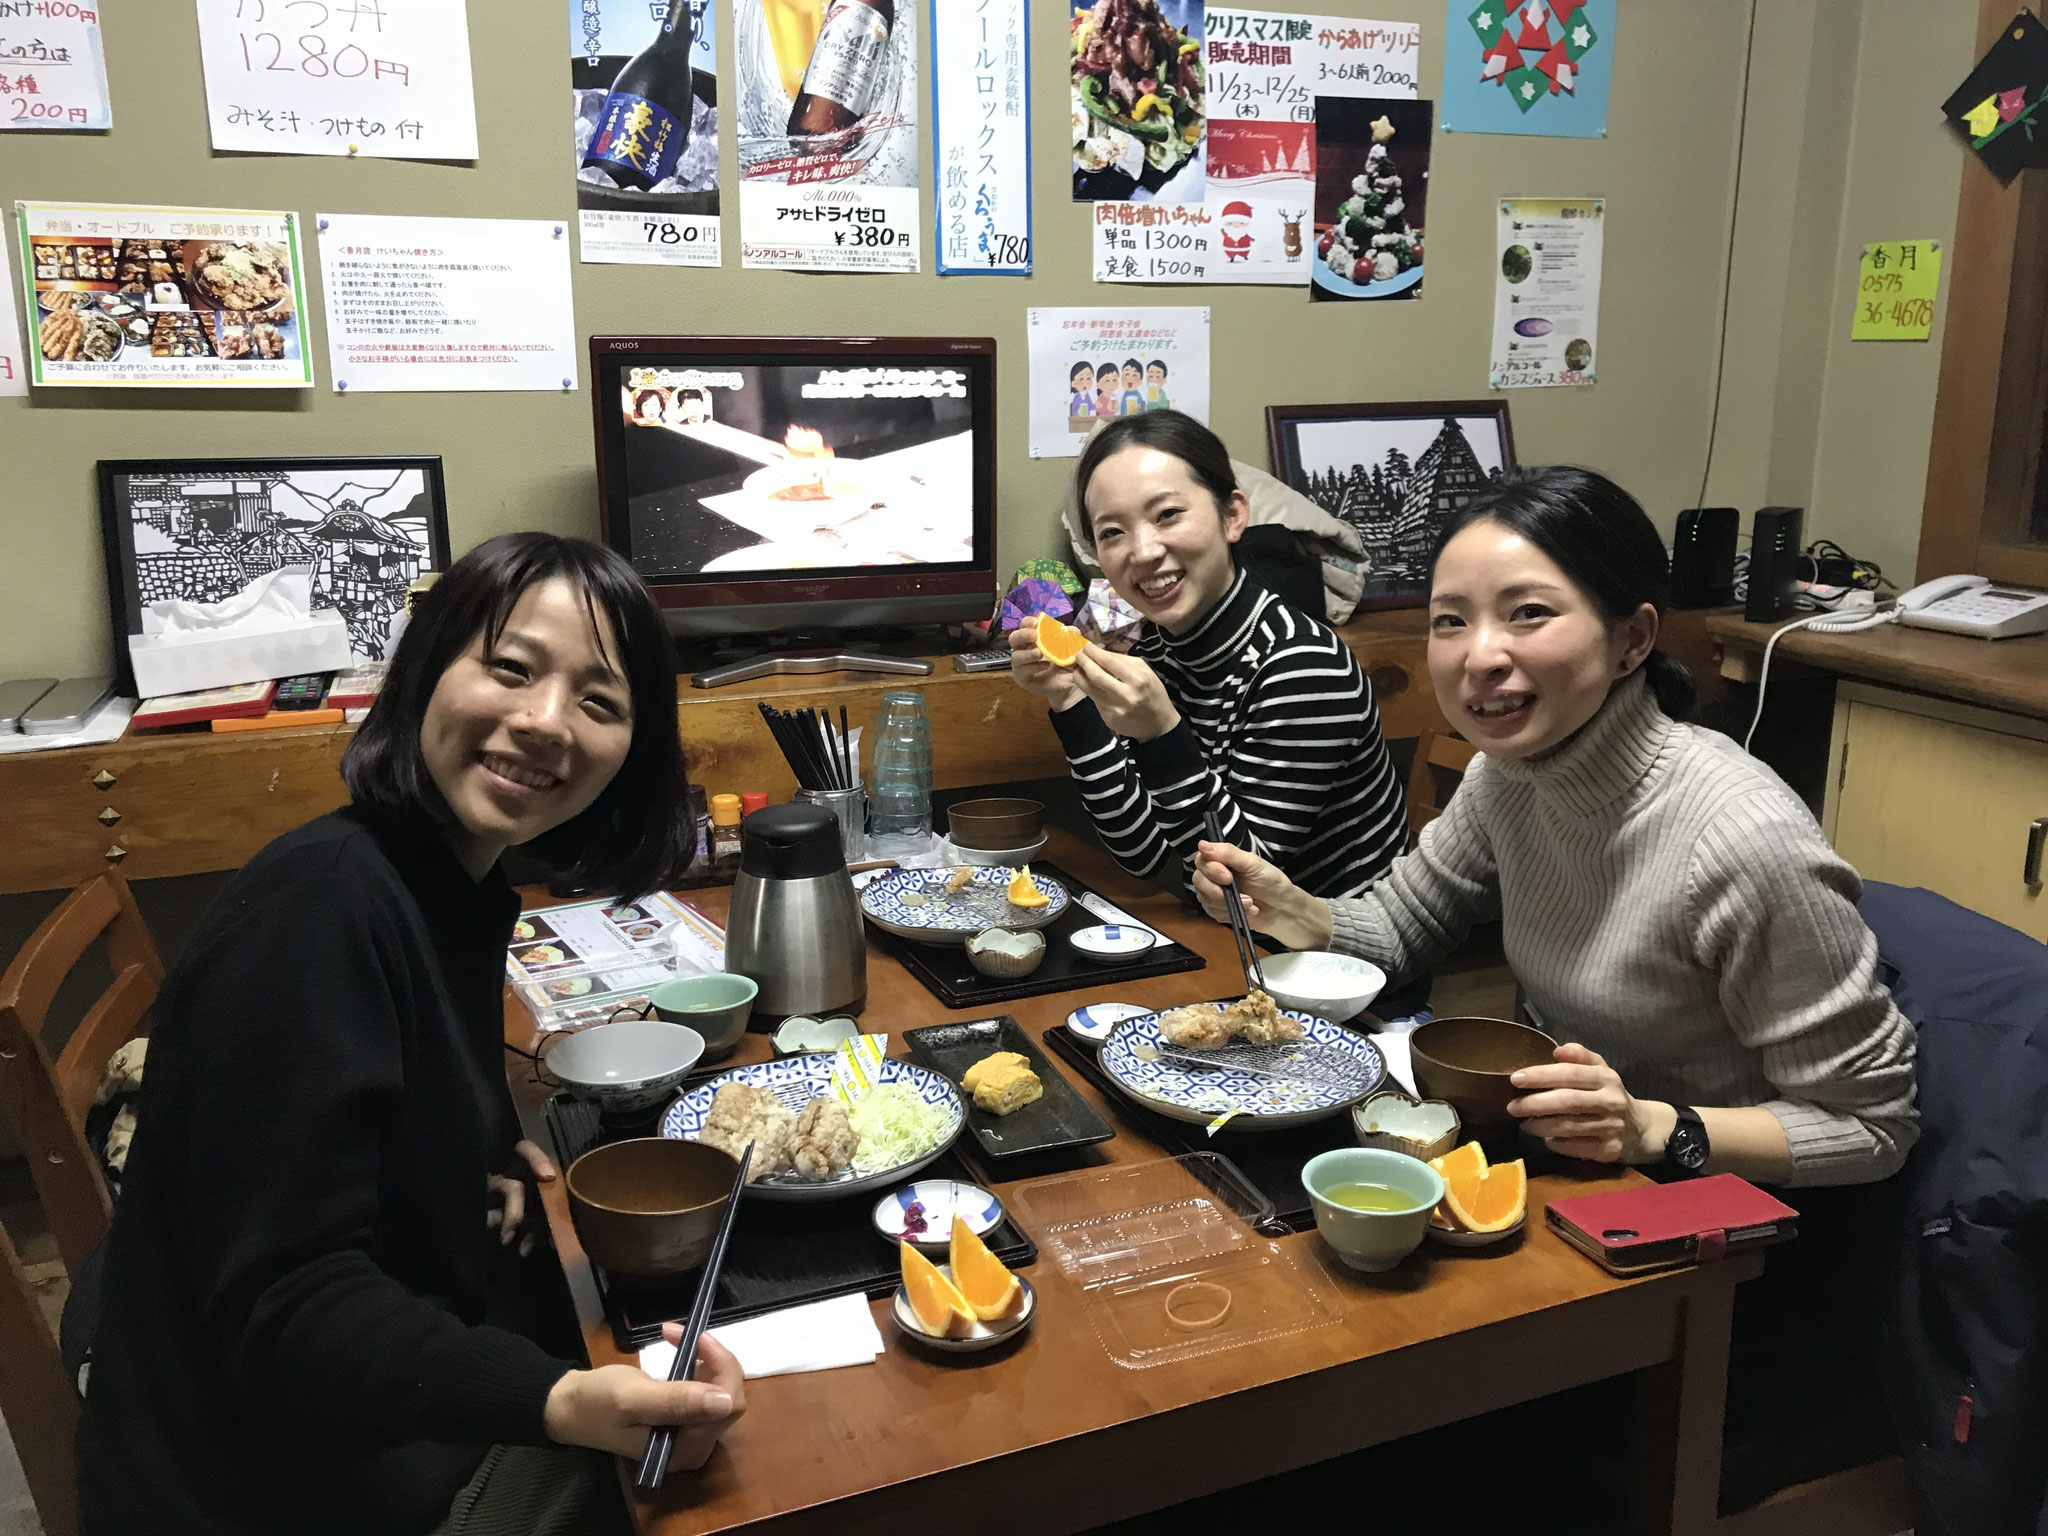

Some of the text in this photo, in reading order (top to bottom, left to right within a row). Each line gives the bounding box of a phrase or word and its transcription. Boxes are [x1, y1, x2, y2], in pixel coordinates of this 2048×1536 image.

[1205, 12, 1313, 42] クリスマス限定
[1208, 40, 1292, 67] 販売期間
[1318, 28, 1420, 54] からあげツリー
[239, 32, 409, 87] 1280円
[11, 98, 87, 123] 200円
[226, 104, 425, 141] みそ汁・つけもの 付
[1235, 103, 1260, 118] (木)
[609, 101, 654, 171] 豪快
[776, 206, 886, 223] アサヒドライゼロ
[946, 146, 968, 258] が飲める店
[1096, 203, 1212, 227] 肉倍増けいちゃん
[643, 222, 717, 244] 780円
[1105, 228, 1208, 251] 単品 1300円
[747, 249, 803, 259] ノンアルコール
[987, 233, 1028, 267] ¥780
[1870, 245, 1917, 271] 香月
[1105, 255, 1205, 278] 定食 1500円
[1862, 273, 1903, 292] 0575
[1861, 298, 1934, 327] 36-4678
[610, 342, 639, 350] AQUOS
[1069, 339, 1178, 352] ご予約うけたまわります。
